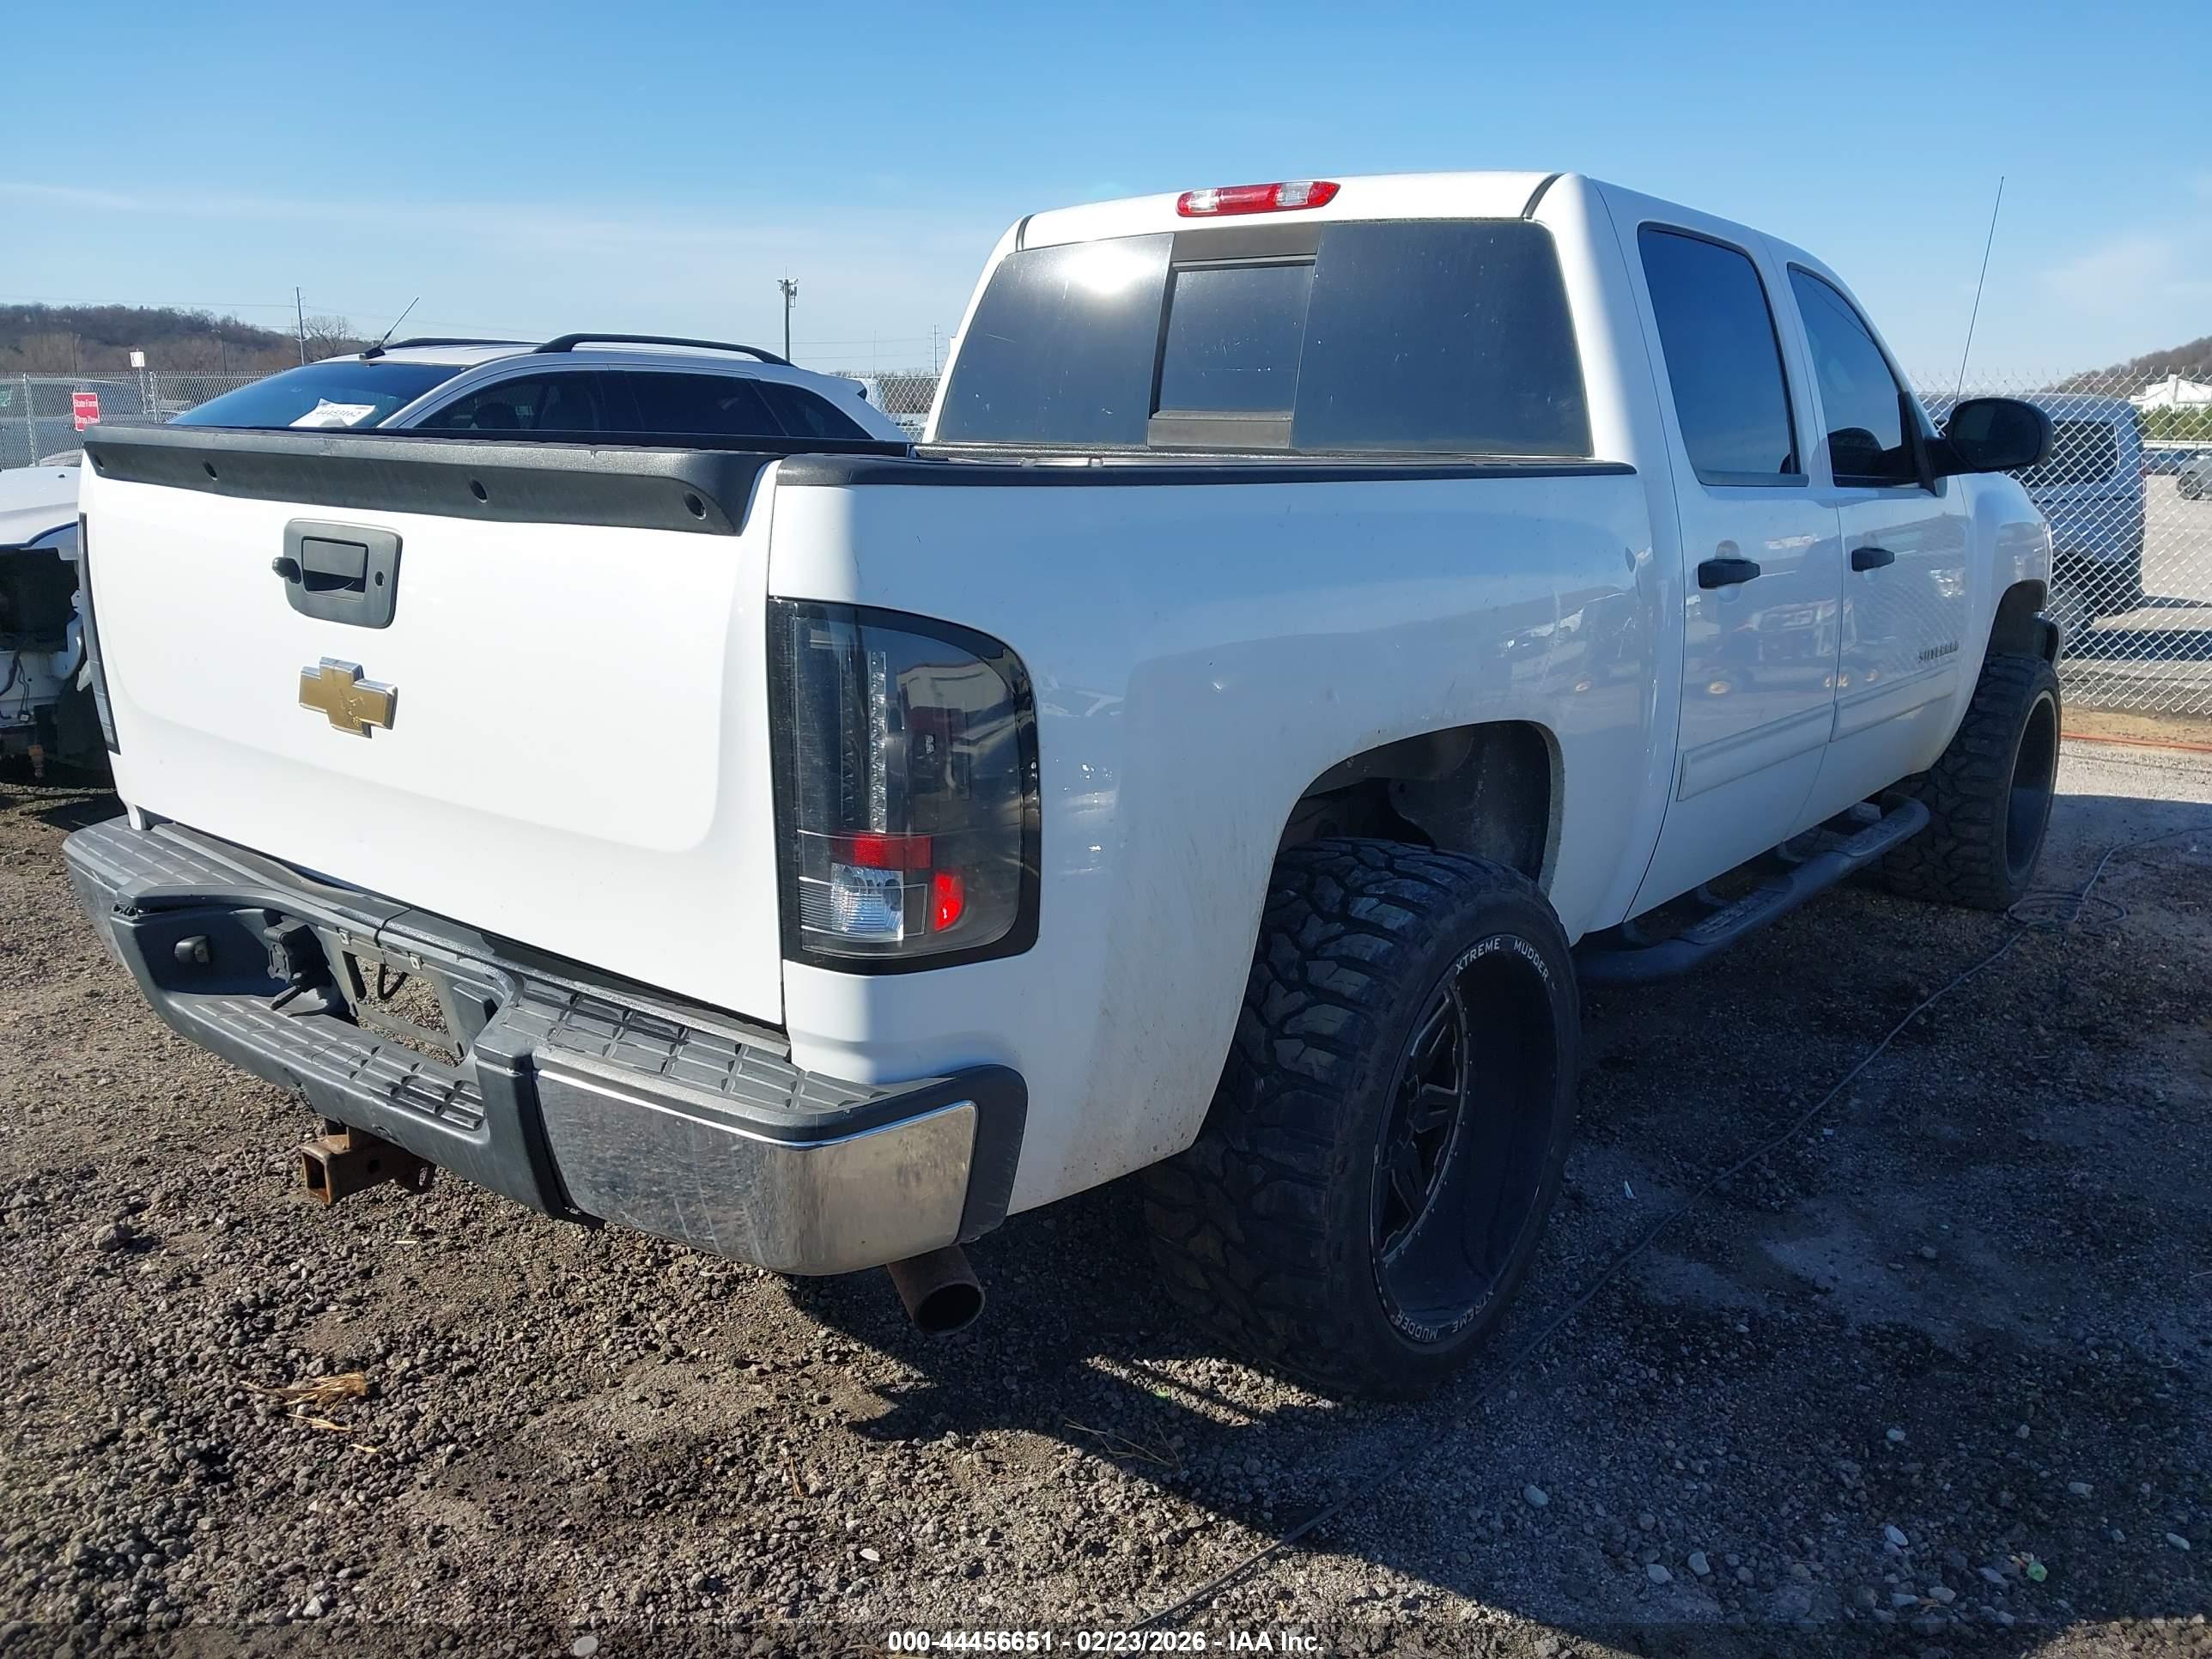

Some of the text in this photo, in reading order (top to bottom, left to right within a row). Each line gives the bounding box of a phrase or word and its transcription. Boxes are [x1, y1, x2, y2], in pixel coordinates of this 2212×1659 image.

[74, 398, 86, 407] State
[1455, 938, 1550, 981] XTREME MUDDER
[1395, 1309, 1439, 1340] MUDDER
